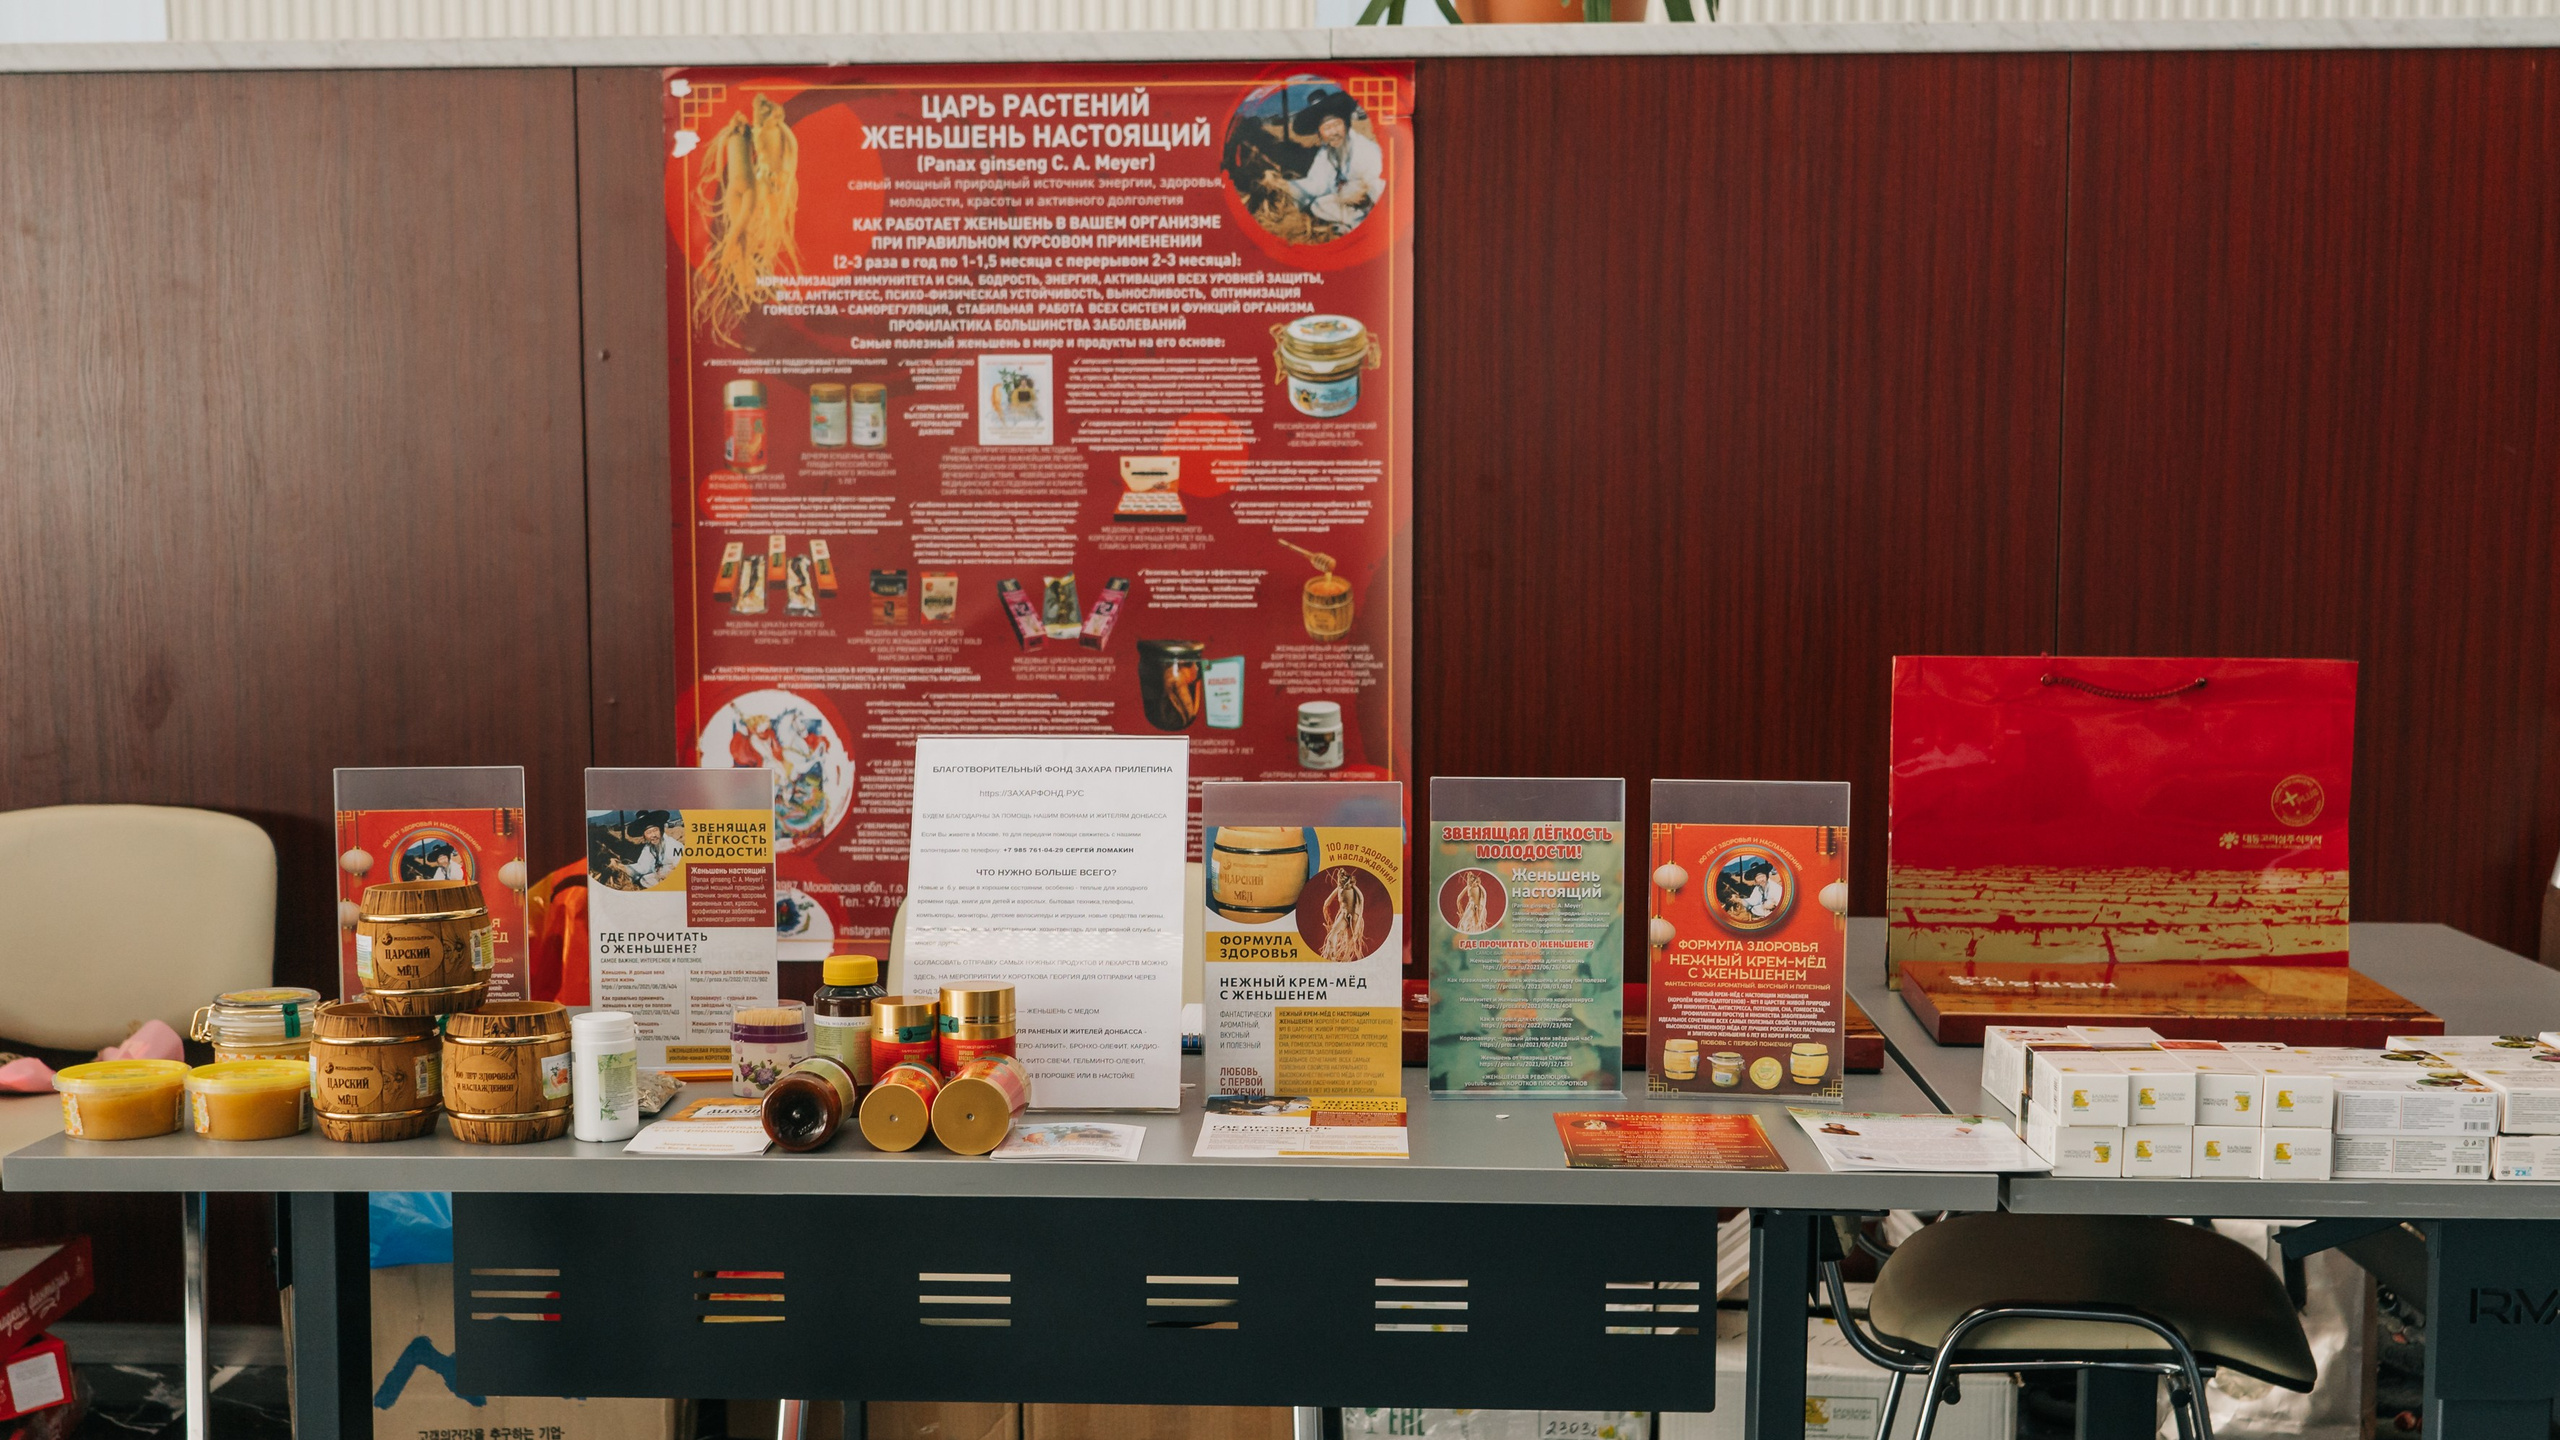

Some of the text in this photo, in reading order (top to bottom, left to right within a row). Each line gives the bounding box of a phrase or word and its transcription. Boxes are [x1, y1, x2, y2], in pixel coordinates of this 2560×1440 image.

[922, 86, 1149, 122] ЦАРЬ РАСТЕНИЙ
[861, 116, 1210, 151] ЖЕНЬШЕНЬ НАСТОЯЩИЙ
[918, 153, 1155, 175] (Panax ginseng C. A. Meyer)
[848, 176, 1226, 192] самый мощный природный источник энергии, здоровья,
[889, 195, 1184, 210] молодости, красоты и активного долголетия
[853, 215, 1221, 231] КАК РАБОТАЕТ ЖЕНЬШЕНЬ В ВАШЕМ ОРГАНИЗМЕ
[872, 234, 1202, 250] ПРИ ПРАВИЛЬНОМ КУРСОВОМ ПРИМЕНЕНИИ
[834, 252, 1241, 271] (2-3 раза в год по 1-1,5 месяца с перерывом 2-3 месяца):
[889, 315, 1186, 332] ПРОФИЛАКТИКА БОЛЬШИНСТВА ЗАБОЛЕВАНИЙ
[850, 336, 1225, 351] Самые полезный женьшень в мире и продукты на его основе:
[932, 765, 1042, 773] БЛАГОТВОРИТЕЛЬНЫЙ
[1044, 766, 1073, 774] ФОНД
[692, 823, 766, 833] ЗВЕНЯЩАЯ
[1442, 824, 1612, 843] ЗВЕНЯЩАЯ ЛЁГКОСТЬ
[696, 834, 766, 844] ЛЁГКОСТЬ
[673, 847, 766, 858] МОЛОДОСТИ!
[1326, 842, 1341, 852] 100
[1361, 845, 1398, 872] здоровья
[1476, 844, 1582, 860] МОЛОДОСТИ!
[691, 866, 766, 876] Женьшень настоящий
[1338, 853, 1396, 884] наслаждения!
[1512, 868, 1600, 884] Женьшень
[803, 881, 906, 894] Московская обл., г.о.
[1512, 884, 1602, 900] настоящий
[839, 896, 864, 906] Тел.:
[600, 932, 708, 943] ГДЕ ПРОЧИТАТЬ
[840, 926, 890, 938] instagram
[1220, 936, 1292, 946] ФОРМУЛА
[1459, 940, 1594, 949] ГДЕ ПРОЧИТАТЬ О ЖЕНЬШЕНЕ?
[1678, 939, 1818, 952] ФОРМУЛА ЗДОРОВЬЯ
[385, 947, 430, 962] ЦАРСКИЙ
[600, 944, 697, 954] О ЖЕНЬШЕНЕ?
[1220, 948, 1297, 960] ЗДОРОВЬЯ
[1670, 952, 1827, 969] НЕЖНЫЙ КРЕМ-МЁД
[397, 964, 420, 978] МЁД
[1688, 967, 1807, 981] С ЖЕНЬШЕНЕМ
[1220, 975, 1367, 989] НЕЖНЫЙ КРЕМ-МЁД
[1220, 990, 1327, 1000] С ЖЕНЬШЕНЕМ
[1220, 1010, 1272, 1018] ФАНТАСТИЧЕСКИ
[1220, 1020, 1260, 1029] АРОМАТНЫЙ,
[1220, 1030, 1250, 1039] ВКУСНЫЙ
[1226, 1040, 1261, 1049] ПОЛЕЗНЫЙ
[1220, 1067, 1258, 1076] ЛЮБОВЬ
[327, 1078, 369, 1090] ЦАРСКИЙ
[1220, 1076, 1263, 1086] С ПЕРВОЙ
[338, 1094, 359, 1108] МЁД
